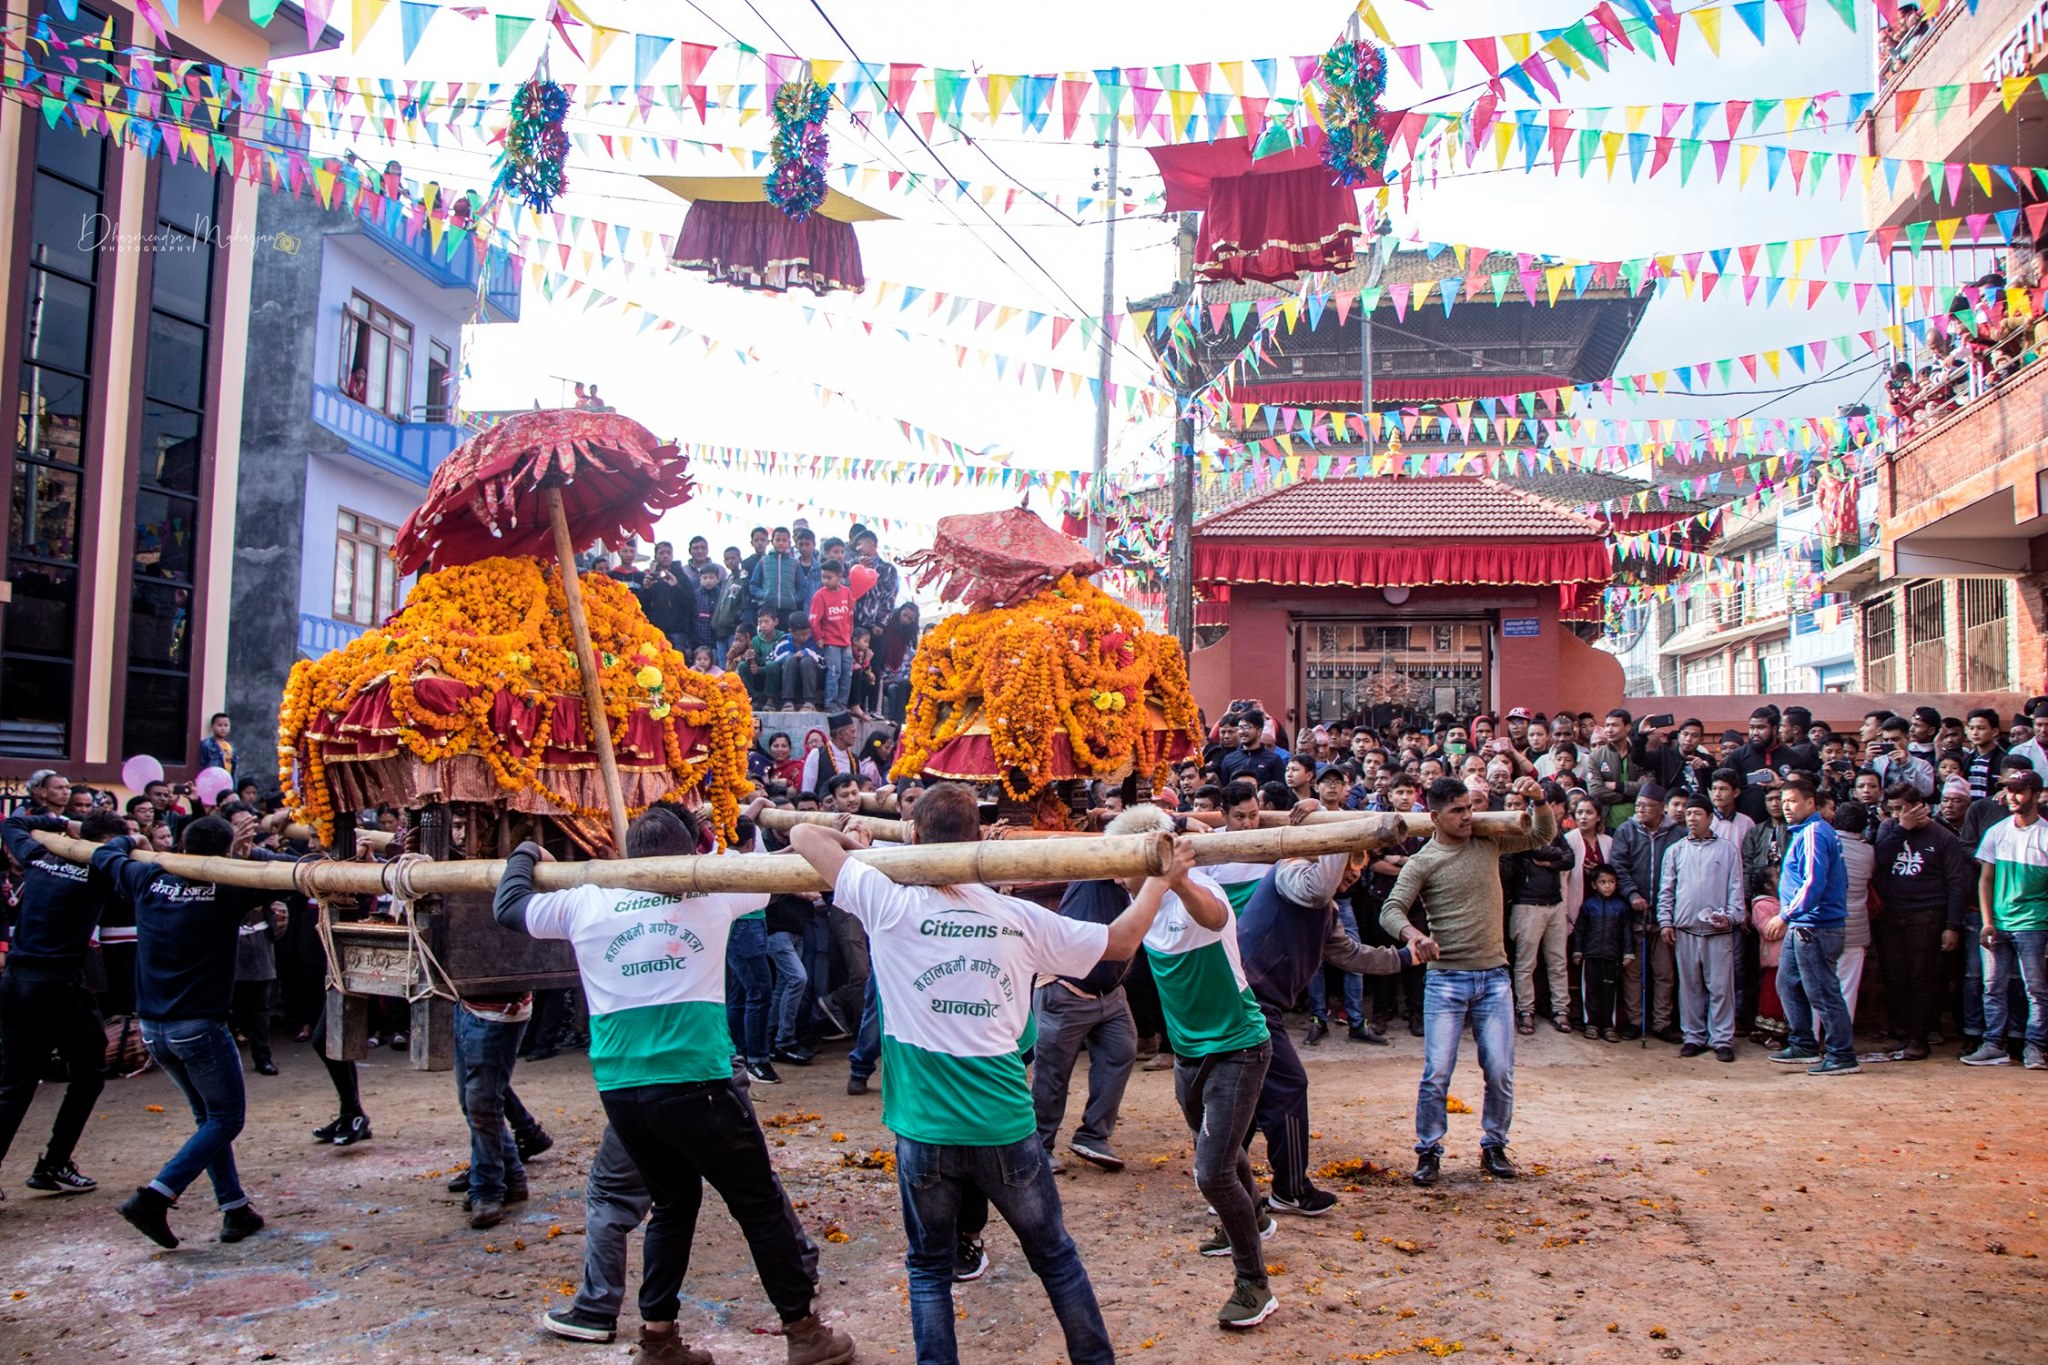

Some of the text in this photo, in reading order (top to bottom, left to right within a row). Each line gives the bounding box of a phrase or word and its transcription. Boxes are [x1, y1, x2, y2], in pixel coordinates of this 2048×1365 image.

[614, 893, 682, 913] Citizens
[920, 918, 1025, 938] Citizens Bank
[604, 919, 705, 963] महालक्ष्मी गणेश जात्रा
[621, 954, 687, 977] थानकोट
[912, 954, 967, 992] महालक्ष्मी
[970, 958, 1001, 979] गणेश
[931, 998, 1001, 1018] थानकोट
